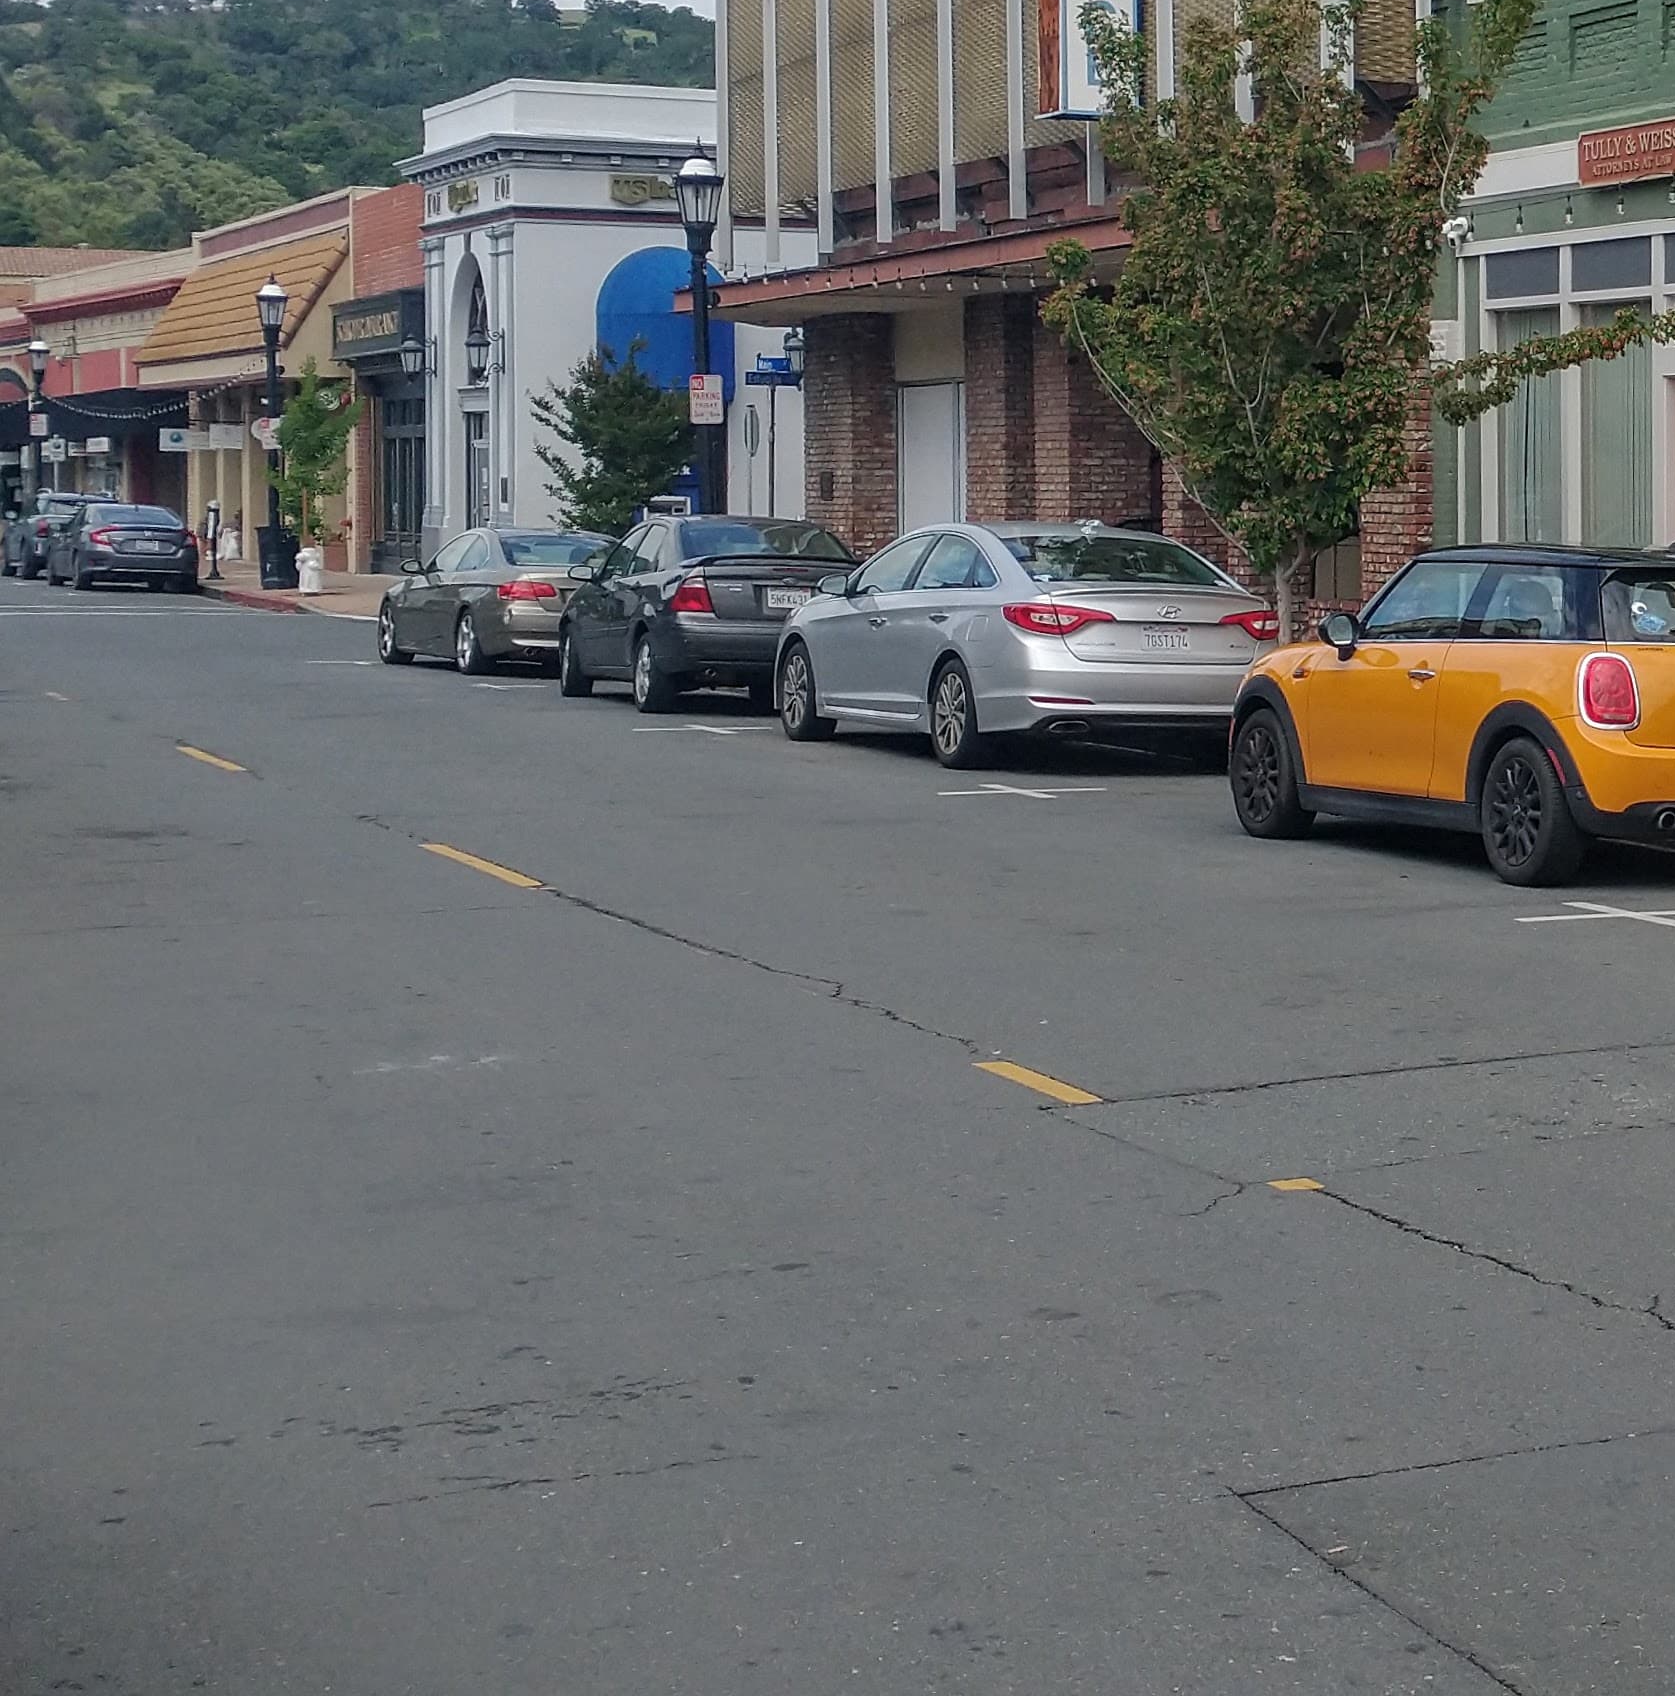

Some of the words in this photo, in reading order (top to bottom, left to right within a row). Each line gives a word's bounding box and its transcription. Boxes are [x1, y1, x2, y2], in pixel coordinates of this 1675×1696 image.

[1583, 135, 1624, 161] TULLY
[1625, 134, 1636, 154] &
[1592, 158, 1640, 177] ATTORNEYS
